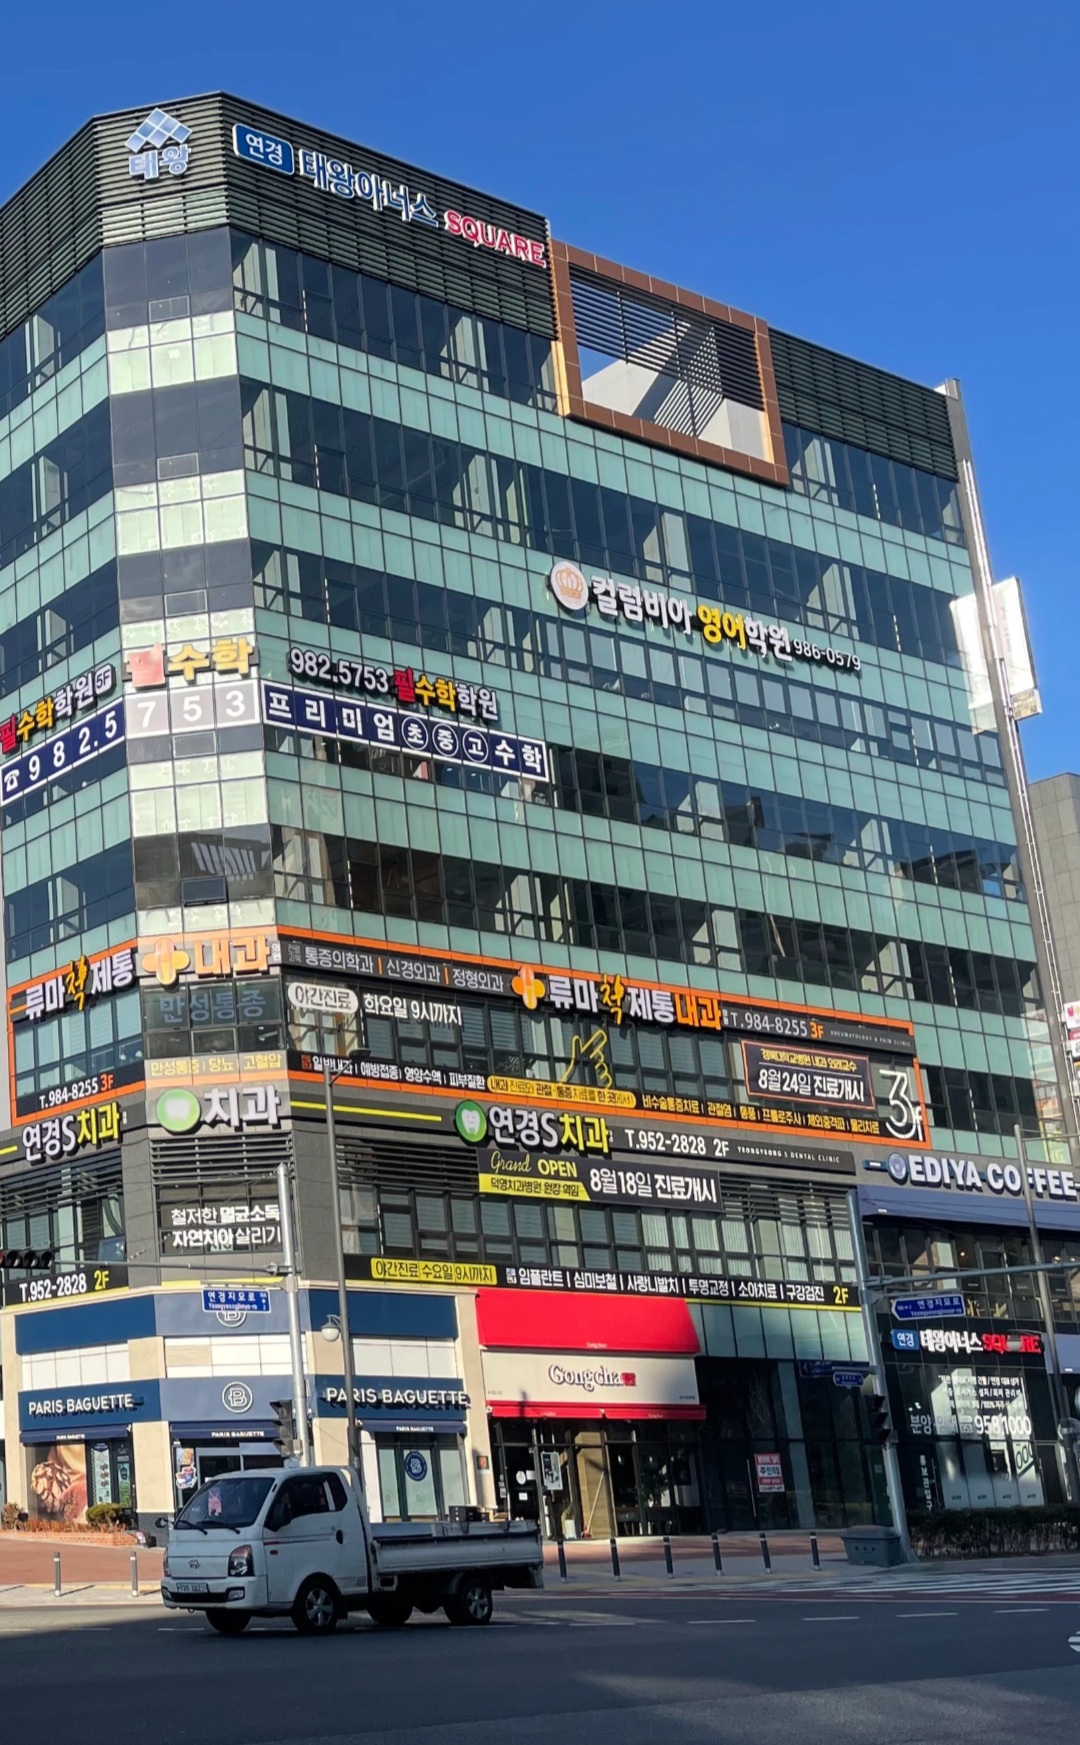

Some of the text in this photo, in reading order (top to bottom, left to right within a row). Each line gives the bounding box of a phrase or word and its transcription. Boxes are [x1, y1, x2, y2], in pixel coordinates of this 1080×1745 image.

[129, 144, 191, 180] 태왕
[246, 134, 547, 268] 연경 태왕아너스 SQUARE
[591, 576, 692, 635] 컬럼비아
[793, 639, 861, 671] 986-0579
[95, 664, 114, 694] 5F
[290, 648, 388, 693] 982.5753
[194, 936, 271, 977] 내과
[304, 946, 504, 992] 통증의학과 신경외과 정형외과
[160, 989, 266, 1023] 만성통증
[295, 983, 462, 1026] 야간진료 화요일 9시까지
[810, 1022, 824, 1039] 3F
[150, 1053, 281, 1077] 만성통증 당뇨 고혈압
[404, 1066, 442, 1085] 영양수액
[449, 1071, 486, 1090] 피부질환
[101, 1073, 114, 1092] 3F
[813, 1075, 864, 1102] 진료개시
[204, 1085, 281, 1127] 치과
[642, 1094, 699, 1114] 비수술통증치료
[707, 1102, 732, 1117] 관절염
[850, 1119, 880, 1134] 물리치료
[22, 1101, 120, 1161] 연경S치과
[489, 1105, 610, 1153] 연경S치과
[624, 1128, 706, 1156] T.952-2828
[713, 1138, 729, 1158] 2F
[490, 1150, 578, 1178] Grand OPEN
[791, 1151, 815, 1161] DENTAL
[818, 1153, 840, 1163] CLINIC
[908, 1154, 983, 1188] EDIYA
[490, 1178, 579, 1197] 덕영치과병원 원장 역임
[654, 1173, 717, 1203] 진료개시
[171, 1204, 280, 1226] 철저한 멸균소독
[172, 1226, 281, 1248] 자연치아 살리기
[19, 1270, 109, 1302] T.952-2828 2F
[375, 1261, 493, 1283] 야간진료 수요일 9시까지
[519, 1267, 848, 1304] 임플란트 심미보철 사랑니발치 투명교정 소아치료 구강검진 2F
[896, 1332, 914, 1347] 연경
[982, 1333, 1041, 1355] SQURE
[29, 1393, 133, 1415] PARIS BAGUETTE
[326, 1388, 467, 1405] PARIS BAGUETTE
